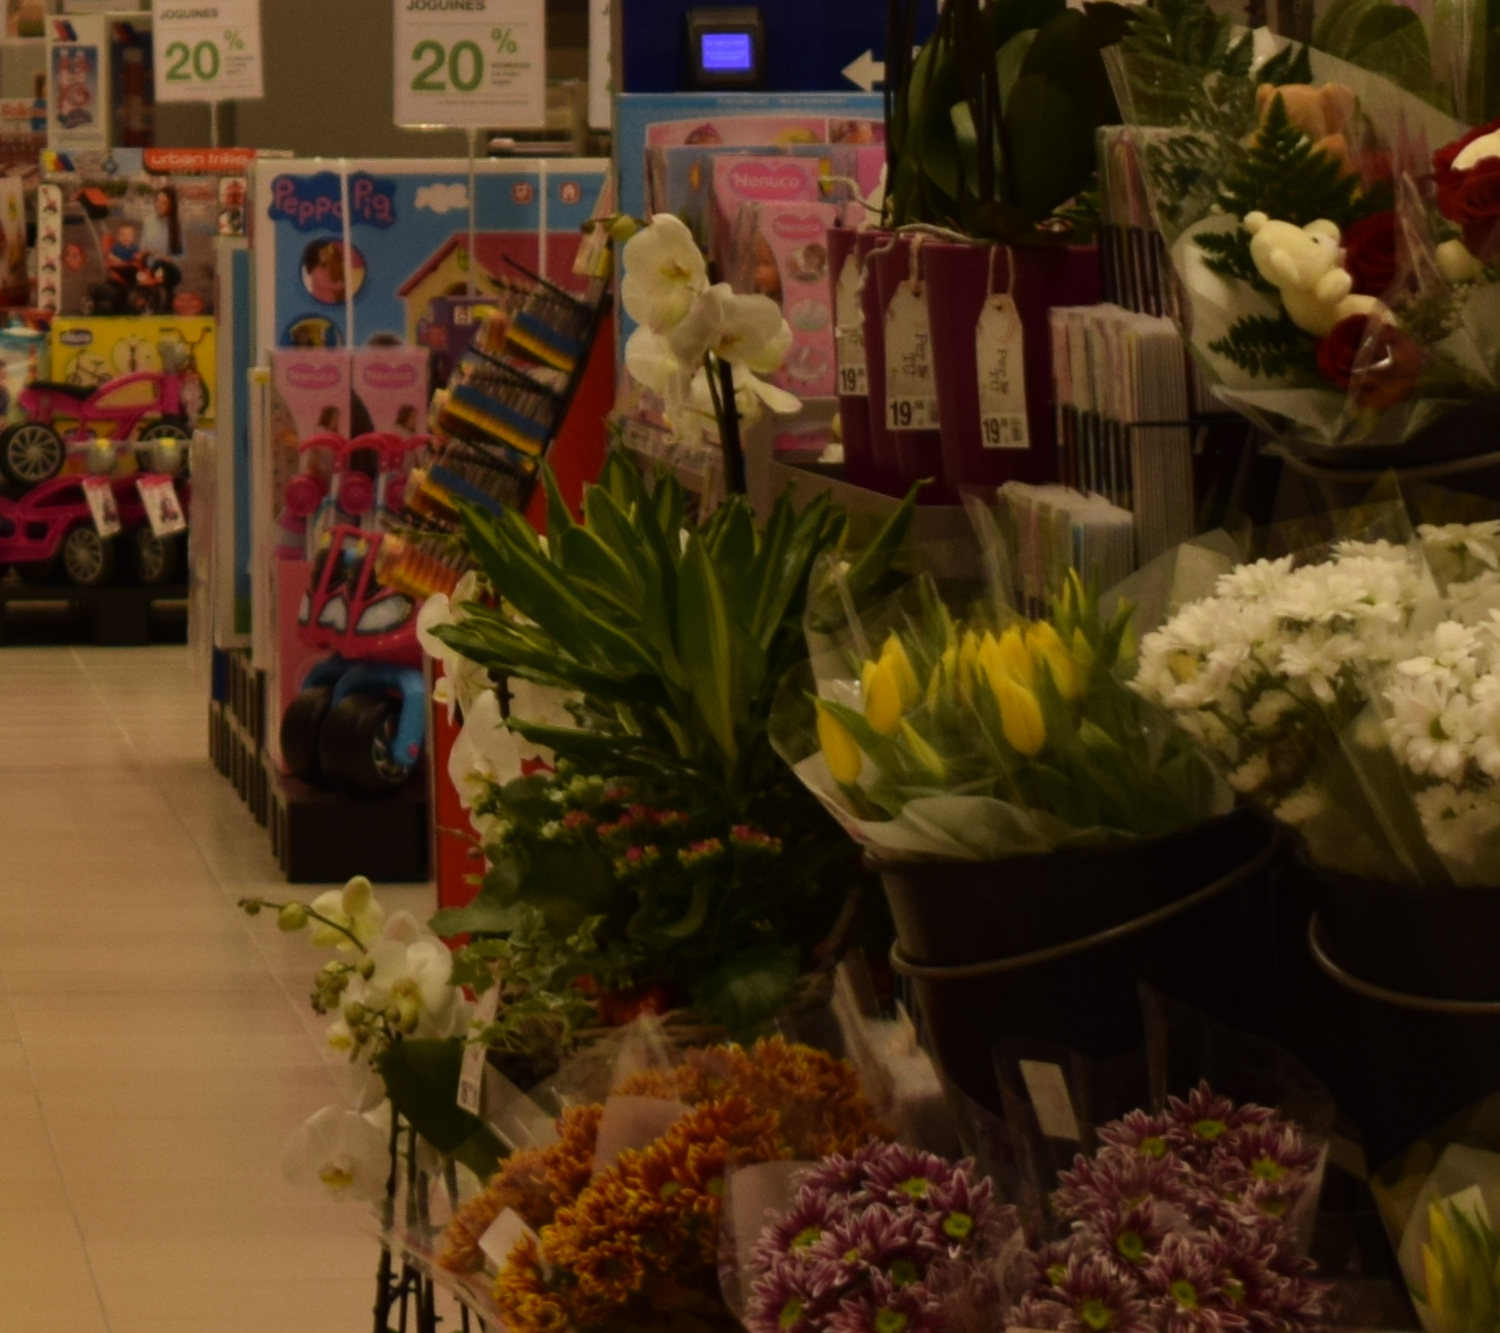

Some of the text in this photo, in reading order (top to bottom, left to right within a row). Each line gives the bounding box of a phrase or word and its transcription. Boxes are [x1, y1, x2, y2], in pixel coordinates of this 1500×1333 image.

[165, 40, 220, 81] 20
[411, 39, 484, 92] 20
[733, 172, 801, 188] Nenuco
[354, 179, 394, 225] Pig
